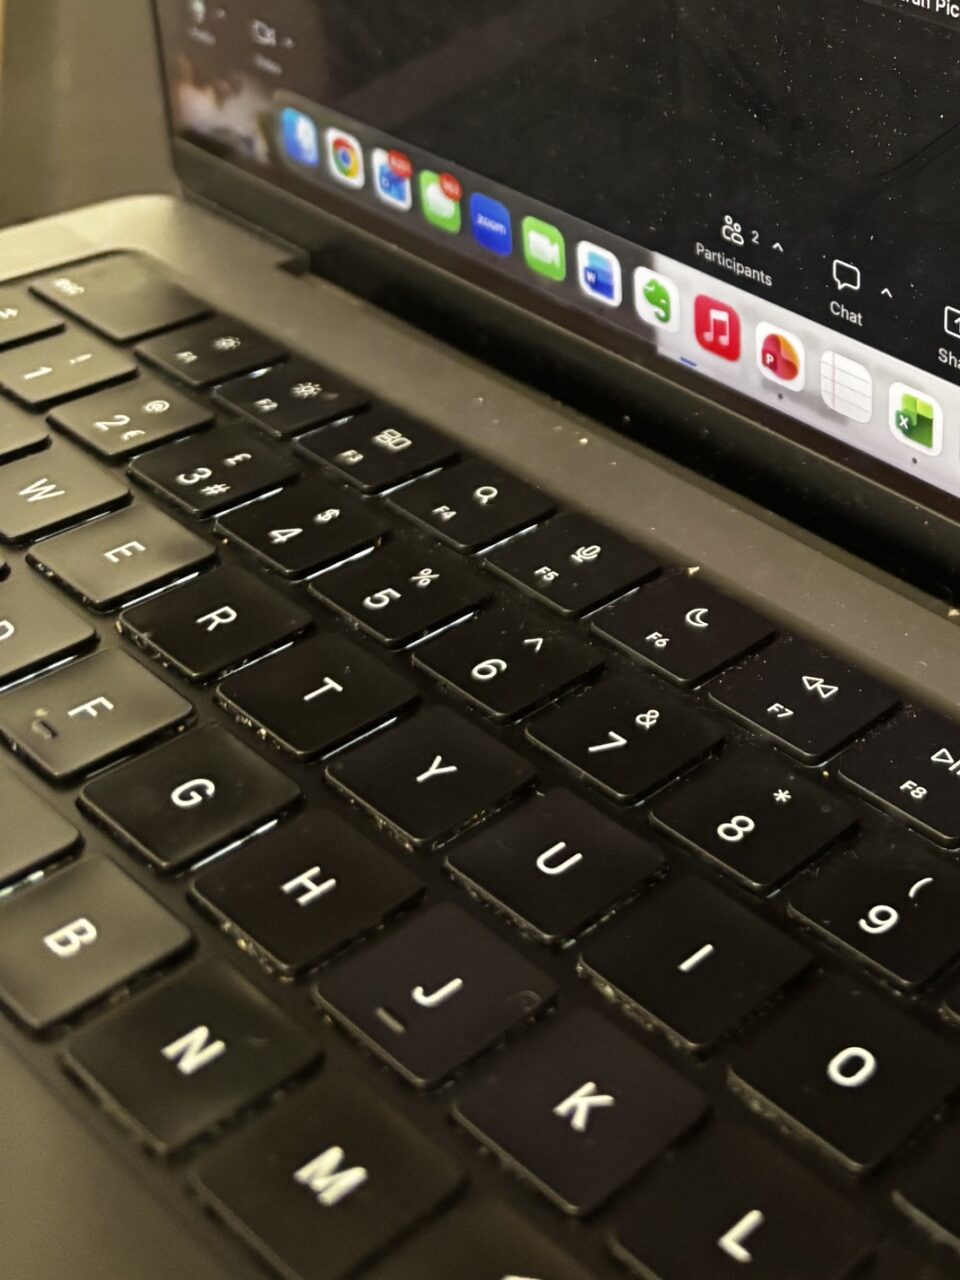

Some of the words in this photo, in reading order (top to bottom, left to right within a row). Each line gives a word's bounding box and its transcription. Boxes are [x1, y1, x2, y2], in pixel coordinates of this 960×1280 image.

[477, 213, 507, 235] zoom
[751, 230, 760, 245] 2
[695, 242, 773, 287] Participants
[829, 300, 863, 327] Chat
[765, 353, 774, 365] P
[23, 366, 53, 380] 1
[142, 399, 170, 413] @
[92, 413, 132, 433] 2
[899, 414, 909, 430] X
[175, 466, 214, 486] 3
[18, 478, 66, 502] W
[432, 505, 457, 521] F4
[269, 527, 303, 544] 4
[103, 540, 146, 564] E
[411, 567, 440, 587] %
[534, 566, 559, 582] F5
[363, 587, 402, 609] 5
[196, 605, 238, 632] R
[645, 631, 670, 648] F6
[471, 658, 508, 680] 6
[303, 676, 344, 701] T
[67, 696, 114, 718] F
[766, 702, 794, 718] F7
[635, 709, 660, 730] &
[587, 730, 628, 753] 7
[416, 755, 458, 783] Y
[170, 778, 216, 808] G
[899, 779, 928, 799] F8
[716, 815, 755, 842] 8
[536, 841, 583, 875] U
[281, 866, 337, 906] H
[858, 904, 899, 934] 9
[43, 917, 98, 957] B
[411, 977, 463, 1007] J
[162, 1025, 225, 1074] N
[554, 1081, 614, 1130] K
[294, 1146, 367, 1205] M
[719, 1209, 762, 1261] L
